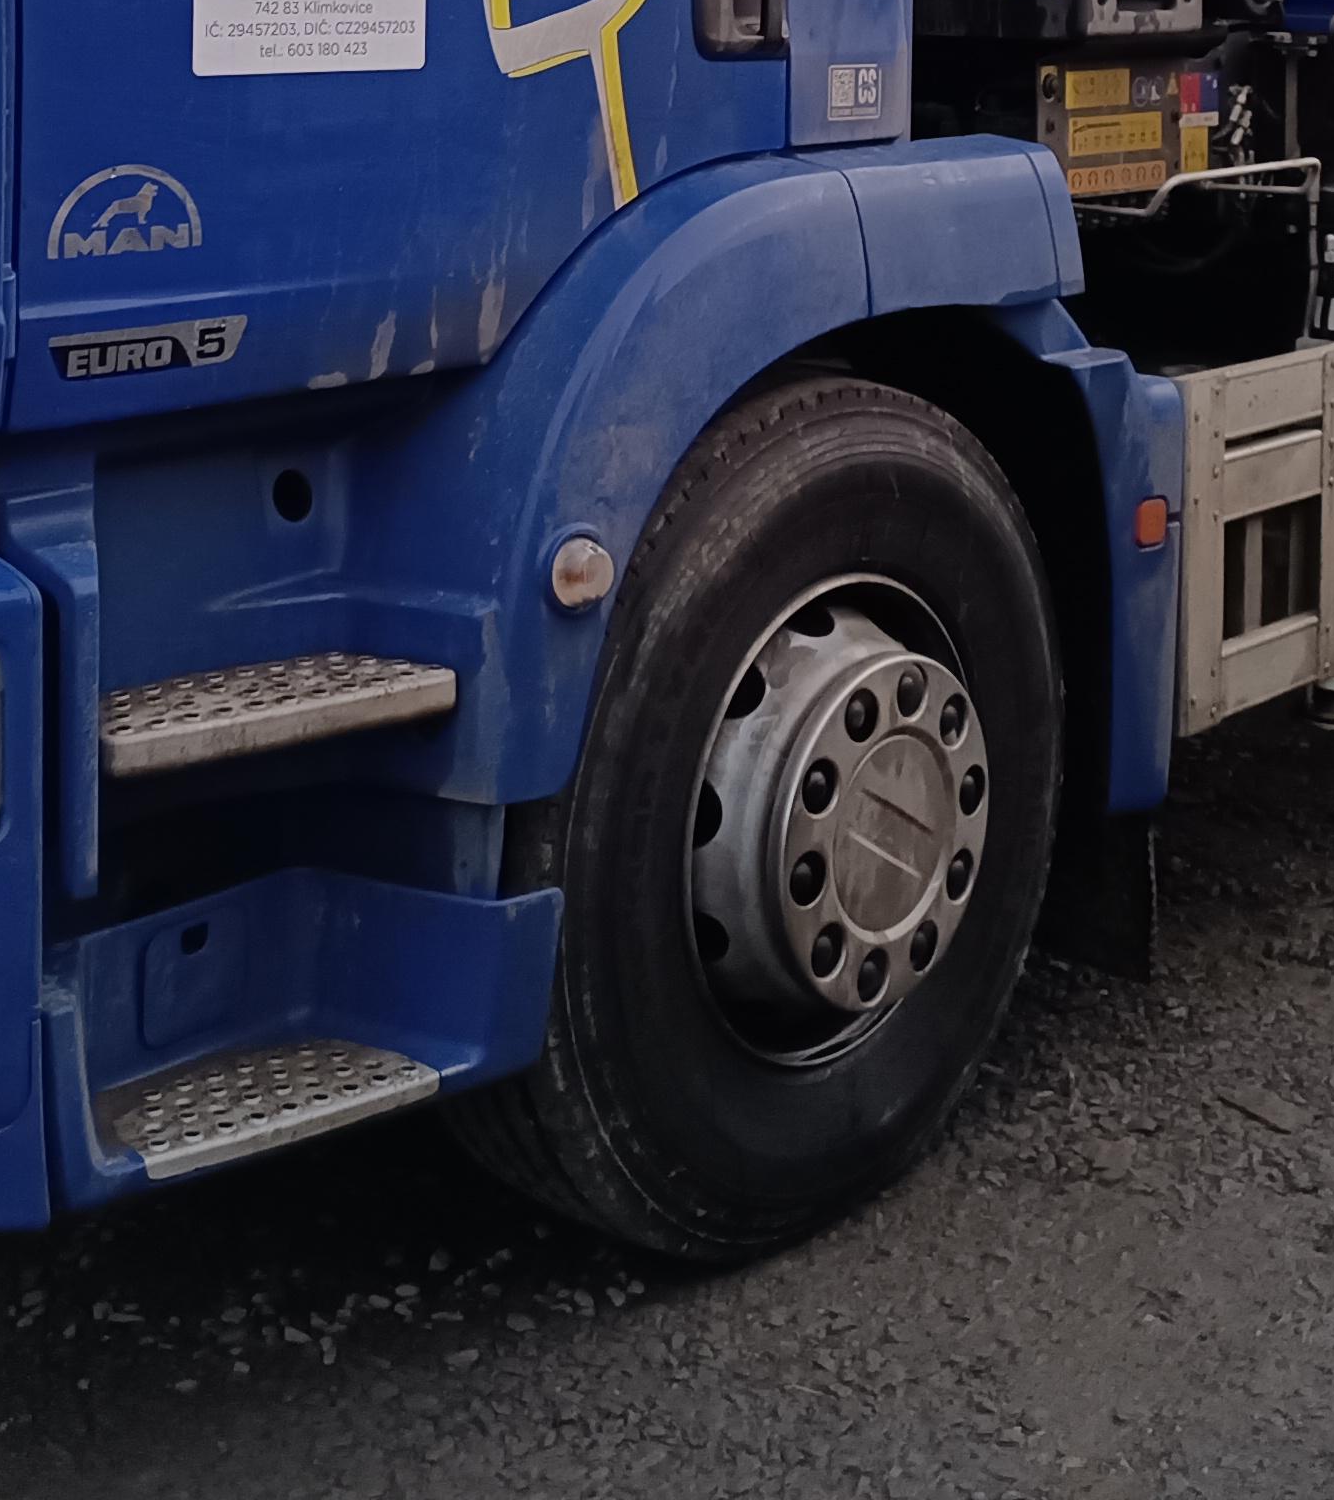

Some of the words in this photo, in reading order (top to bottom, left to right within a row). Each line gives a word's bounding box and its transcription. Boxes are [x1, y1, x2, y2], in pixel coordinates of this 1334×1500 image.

[255, 1, 278, 15] 742
[283, 1, 300, 14] 83
[304, 0, 373, 14] Klimkovice
[205, 21, 223, 37] IČ:
[228, 22, 300, 37] 29457203,
[304, 18, 332, 35] DIČ:
[335, 19, 415, 36] CZ29457203
[287, 44, 314, 57] 603
[318, 43, 340, 57] 180
[343, 41, 368, 55] 423
[64, 222, 189, 260] MAN
[67, 339, 173, 378] EURO
[196, 326, 226, 360] 5
